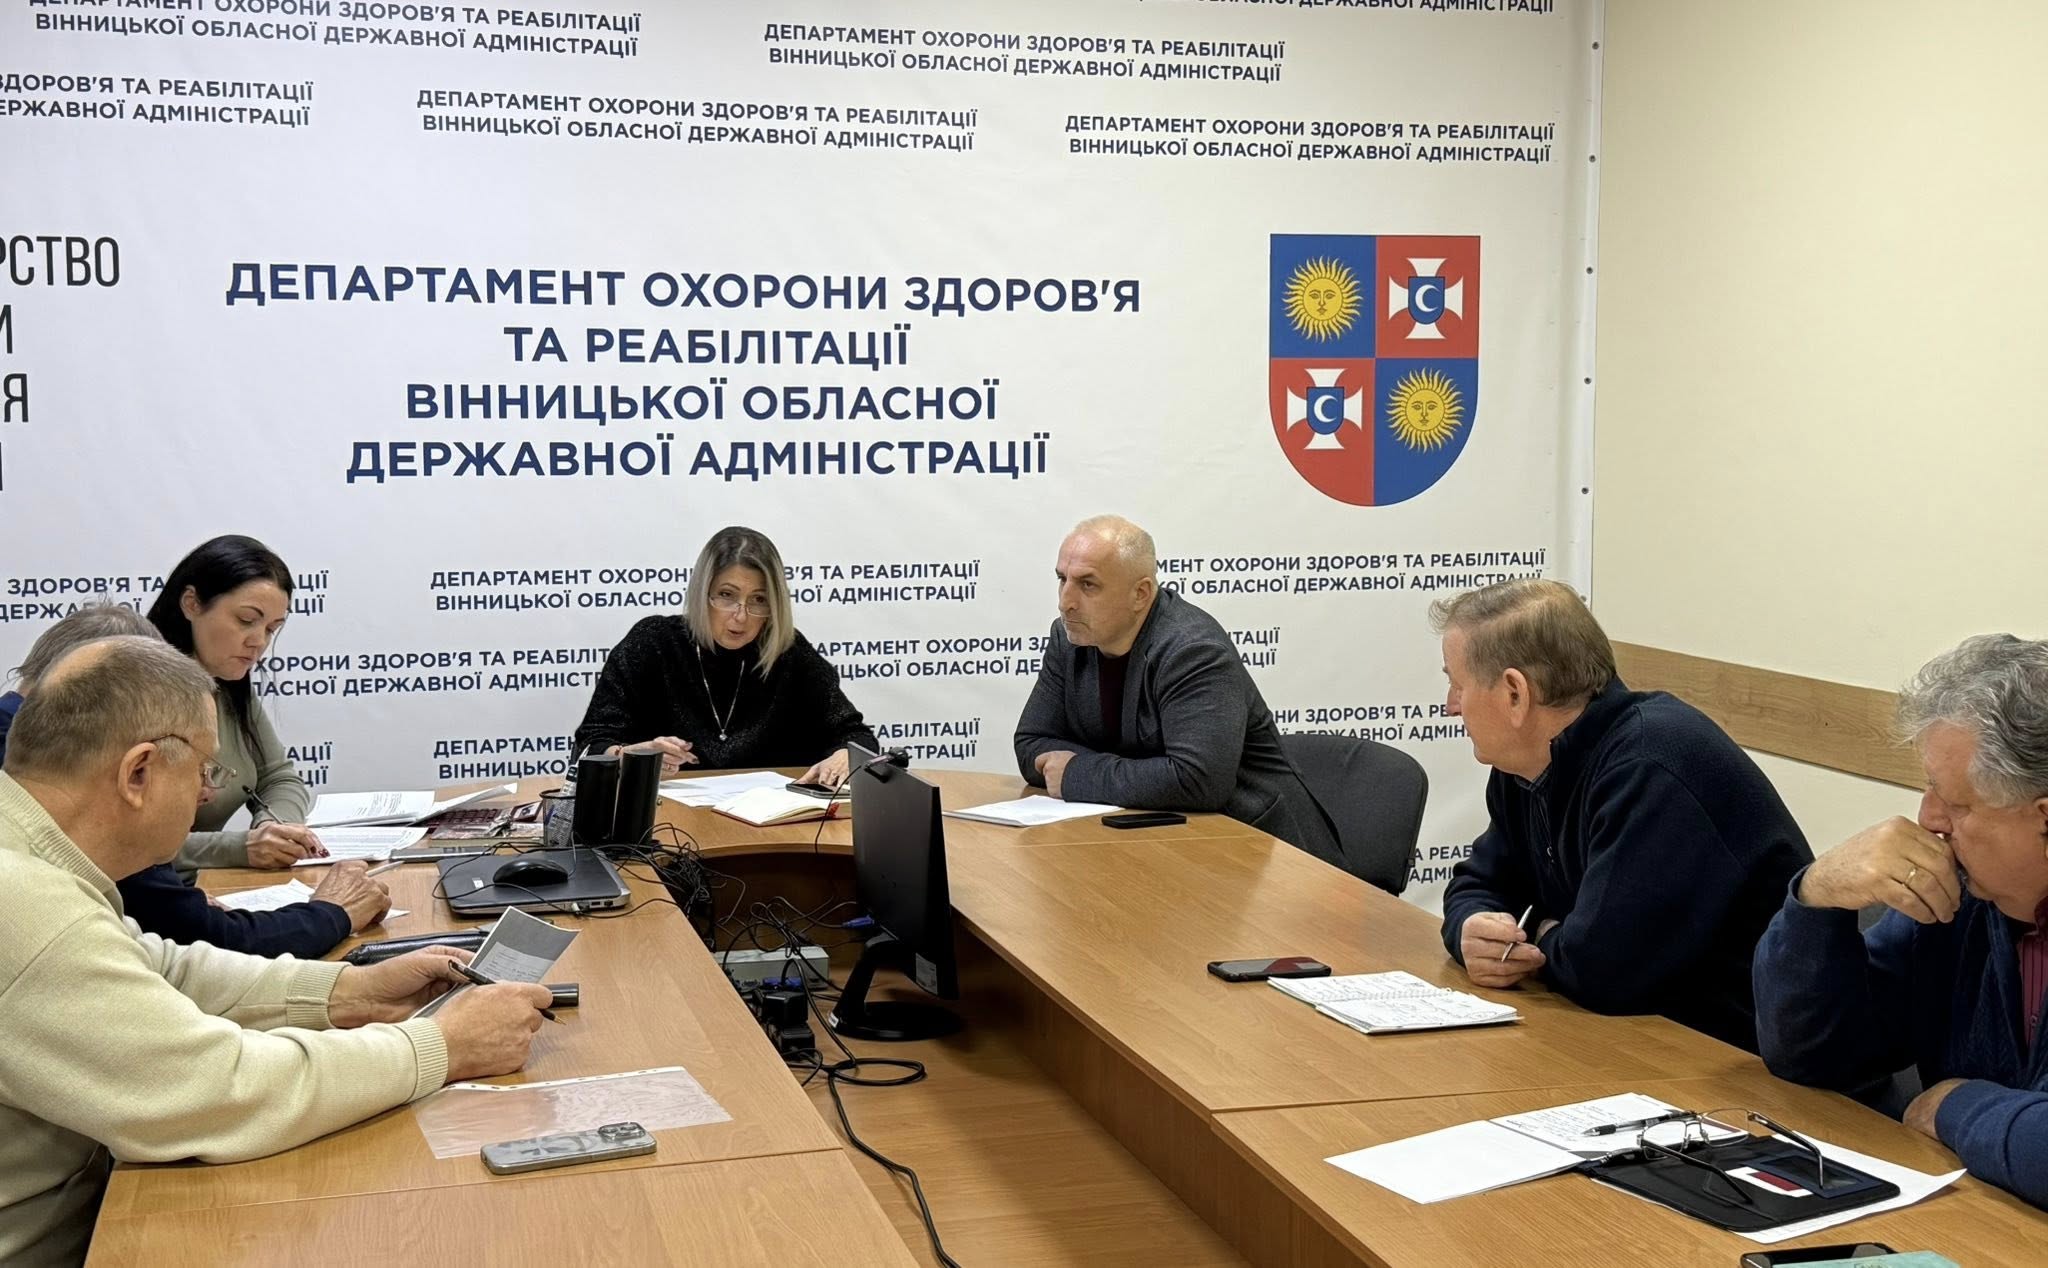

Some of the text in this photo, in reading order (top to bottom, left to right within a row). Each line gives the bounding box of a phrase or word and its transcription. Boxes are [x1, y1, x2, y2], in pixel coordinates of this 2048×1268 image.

[215, 0, 330, 16] ОХОРОНИ
[339, 2, 454, 22] ЗДОРОВ'Я
[462, 8, 489, 24] ТА
[498, 10, 641, 34] РЕАБІЛІТАЦІЇ
[36, 14, 638, 58] ВІННИЦЬКОЇ ОБЛАСНОЇ ДЕРЖАВНОЇ АДМІНІСТРАЦІЇ
[765, 24, 1285, 61] ДЕПАРТАМЕНТ ОХОРОНИ ЗДОРОВ'Я ТА РЕАБІЛІТАЦІЇ
[770, 48, 1281, 83] ВІННИЦЬКОЇ ОБЛАСНОЇ ДЕРЖАВНОЇ АДМІНІСТРАЦІЇ
[122, 78, 151, 94] ТА
[160, 79, 313, 103] РЕАБІЛІТАЦІЇ
[133, 104, 310, 128] АДМІНІСТРАЦІЇ
[417, 90, 977, 129] ДЕПАРТАМЕНТ ОХОРОНИ ЗДОРОВ'Я ТА РЕАБІЛІТАЦІЇ
[424, 115, 974, 152] ВІННИЦЬКОЇ ОБЛАСНОЇ ДЕРЖАВНОЇ АДМІНІСТРАЦІЇ
[1066, 116, 1555, 142] ДЕПАРТАМЕНТ ОХОРОНИ ЗДОРОВ'Я ТА РЕАБІЛІТАЦІЇ
[1070, 138, 1551, 164] ВІННИЦЬКОЇ ОБЛАСНОЇ ДЕРЖАВНОЇ АДМІНІСТРАЦІЇ
[226, 263, 1139, 317] ДЕПАРТАМЕНТ ОХОРОНИ ЗДОРОВ'Я
[504, 324, 911, 371] ТА РЕАБІЛІТАЦІЇ
[408, 377, 999, 426] ВІННИЦЬКОЇ ОБЛАСНОЇ
[347, 433, 1049, 483] ДЕРЖАВНОЇ АДМІНІСТРАЦІЇ
[1210, 557, 1300, 572] ОХОРОНИ
[1307, 555, 1397, 572] ЗДОРОВ'Я
[1403, 554, 1424, 567] ТА
[1431, 549, 1545, 567] РЕАБІЛІТАЦІЇ
[8, 577, 129, 597] ЗДОРОВ'Я
[431, 570, 592, 590] ДЕПАРТАМЕНТ
[599, 567, 692, 585] ОХОРОН
[820, 566, 844, 579] ТА
[852, 560, 980, 580] РЕАБІЛІТАЦІЇ
[1192, 575, 1289, 594] ОБЛАСНОЇ
[1294, 573, 1405, 594] ДЕРЖАВНОЇ
[437, 590, 571, 611] ВІННИЦЬКОЇ
[577, 587, 687, 608] ОБЛАСНО
[829, 582, 976, 604] АДМІНІСТРАЦІЇ
[811, 639, 920, 657] АРТАМЕНТ
[926, 638, 1021, 653] ОХОРОНИ
[358, 652, 471, 672] ЗДОРОВ'Я
[479, 651, 505, 665] ТА
[834, 660, 902, 681] ЦЬКОЇ
[907, 656, 1010, 676] ОБЛАСНОЇ
[343, 672, 482, 697] ДЕРЖАВНОЇ
[1306, 706, 1395, 724] ЗДОРОВ'Я
[1402, 705, 1422, 718] ТА
[1408, 725, 1472, 741] АДМІН
